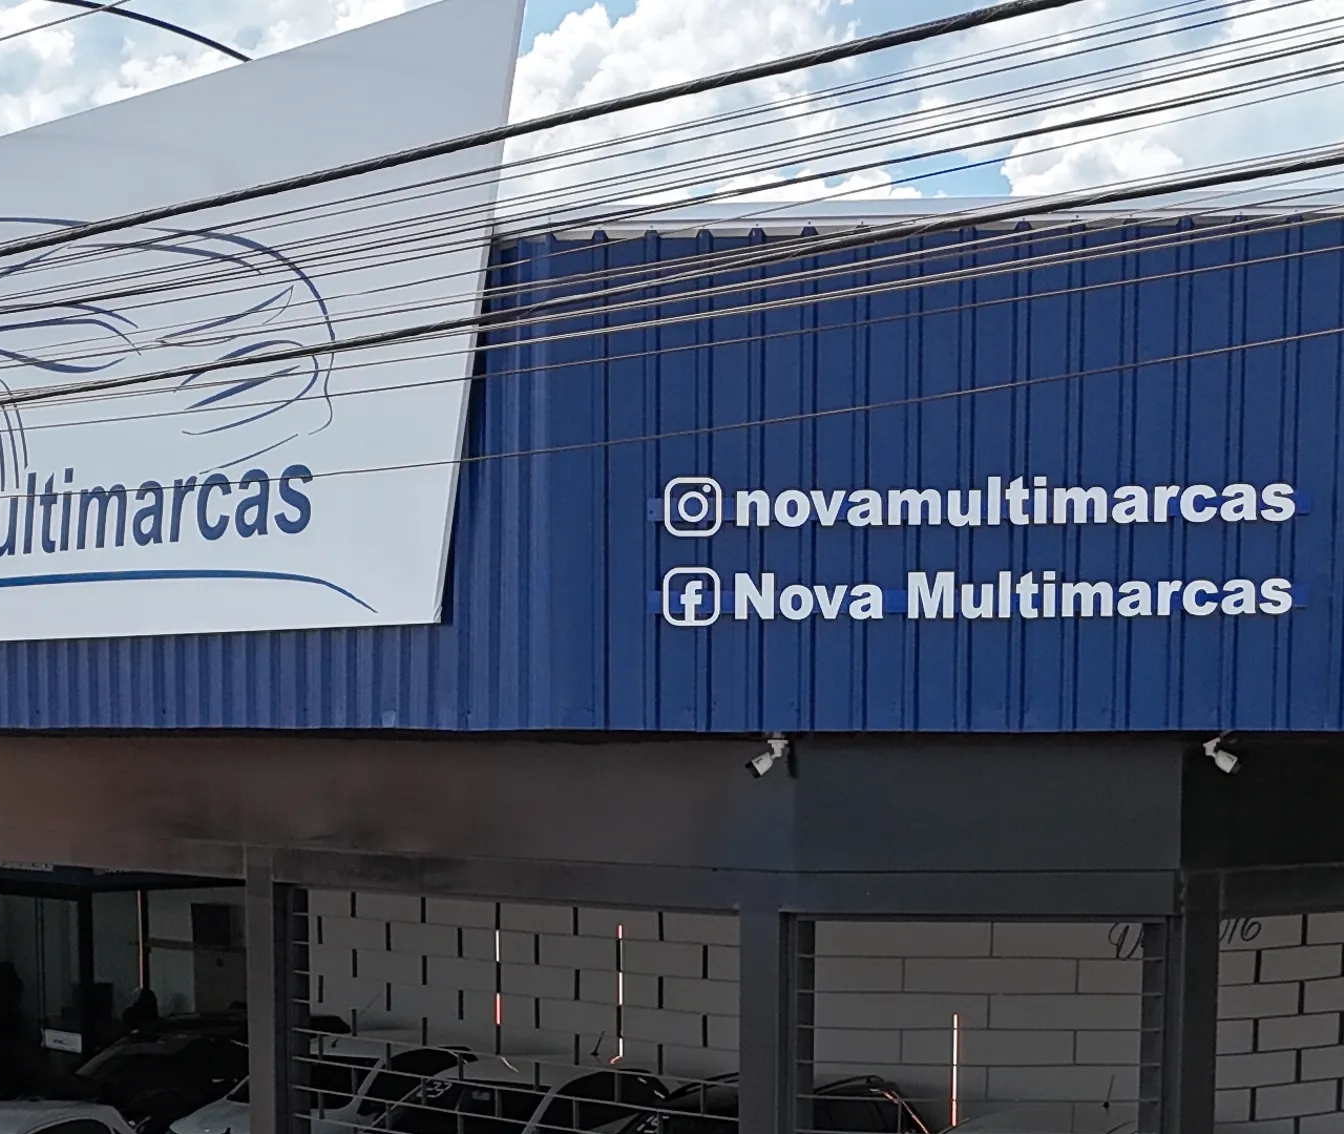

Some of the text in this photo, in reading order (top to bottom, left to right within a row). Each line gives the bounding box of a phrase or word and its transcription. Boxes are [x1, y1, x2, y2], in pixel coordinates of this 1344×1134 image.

[735, 476, 1296, 528] novamultimarcas
[734, 573, 884, 620] Nova
[907, 570, 1293, 619] Multimarcas
